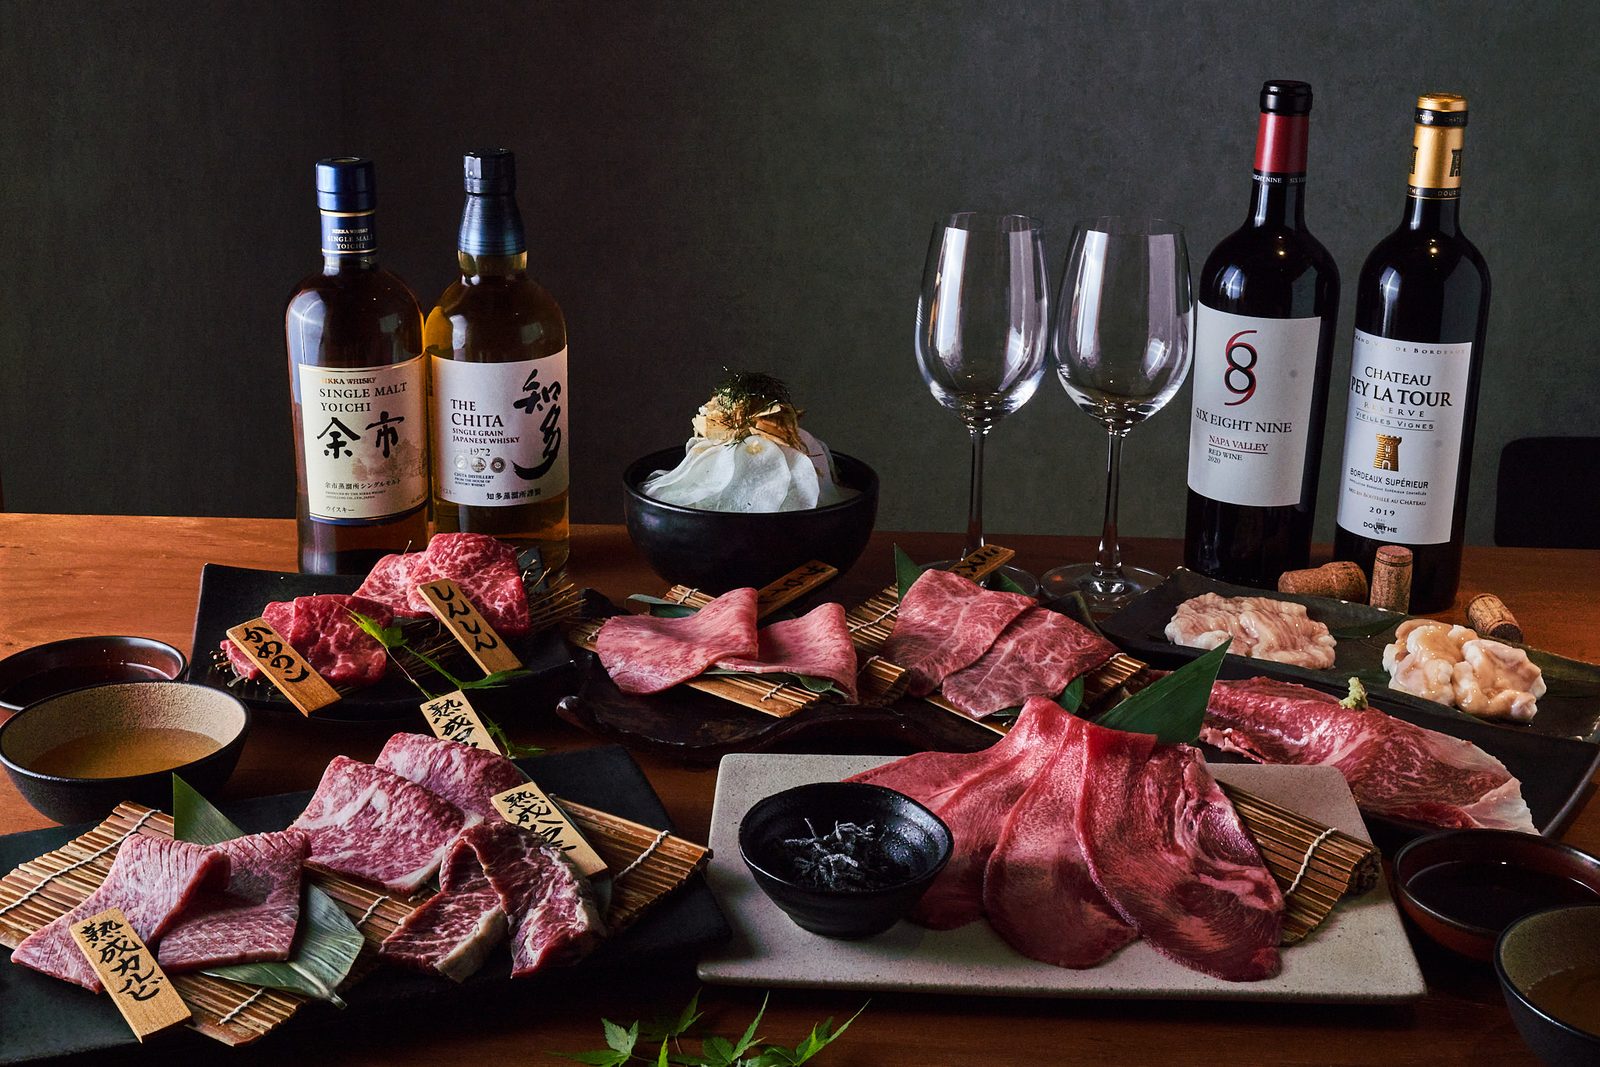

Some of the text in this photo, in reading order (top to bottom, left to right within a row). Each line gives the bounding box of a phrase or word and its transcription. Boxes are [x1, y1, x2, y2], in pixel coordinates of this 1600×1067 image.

[346, 377, 377, 385] WHISKY
[1364, 366, 1432, 387] CHATEAU
[319, 382, 408, 399] SINGLE MALT
[1350, 375, 1453, 408] PEY LA TOUR
[320, 402, 372, 413] YOICHI
[450, 398, 477, 412] THE
[451, 412, 505, 428] CHITA
[511, 368, 562, 481] 知多
[1195, 407, 1292, 433] SIX EIGHT NINE
[1355, 410, 1434, 431] VIEILLES VIGNES
[316, 410, 405, 459] 余市
[452, 428, 504, 437] SINGLE GRAIN
[452, 435, 520, 445] JAPANESE WHISKY
[469, 447, 491, 457] 1972
[1208, 435, 1269, 452] NAPA VALLEY
[1207, 455, 1221, 464] 2020
[1208, 448, 1243, 461] RED WINE
[1349, 466, 1384, 485] BORDEAUX
[1385, 477, 1429, 489] SUPÉRIEUR
[1369, 506, 1396, 517] 2019
[430, 585, 499, 652] しんしん
[81, 920, 164, 1001] 熟成カルビ
